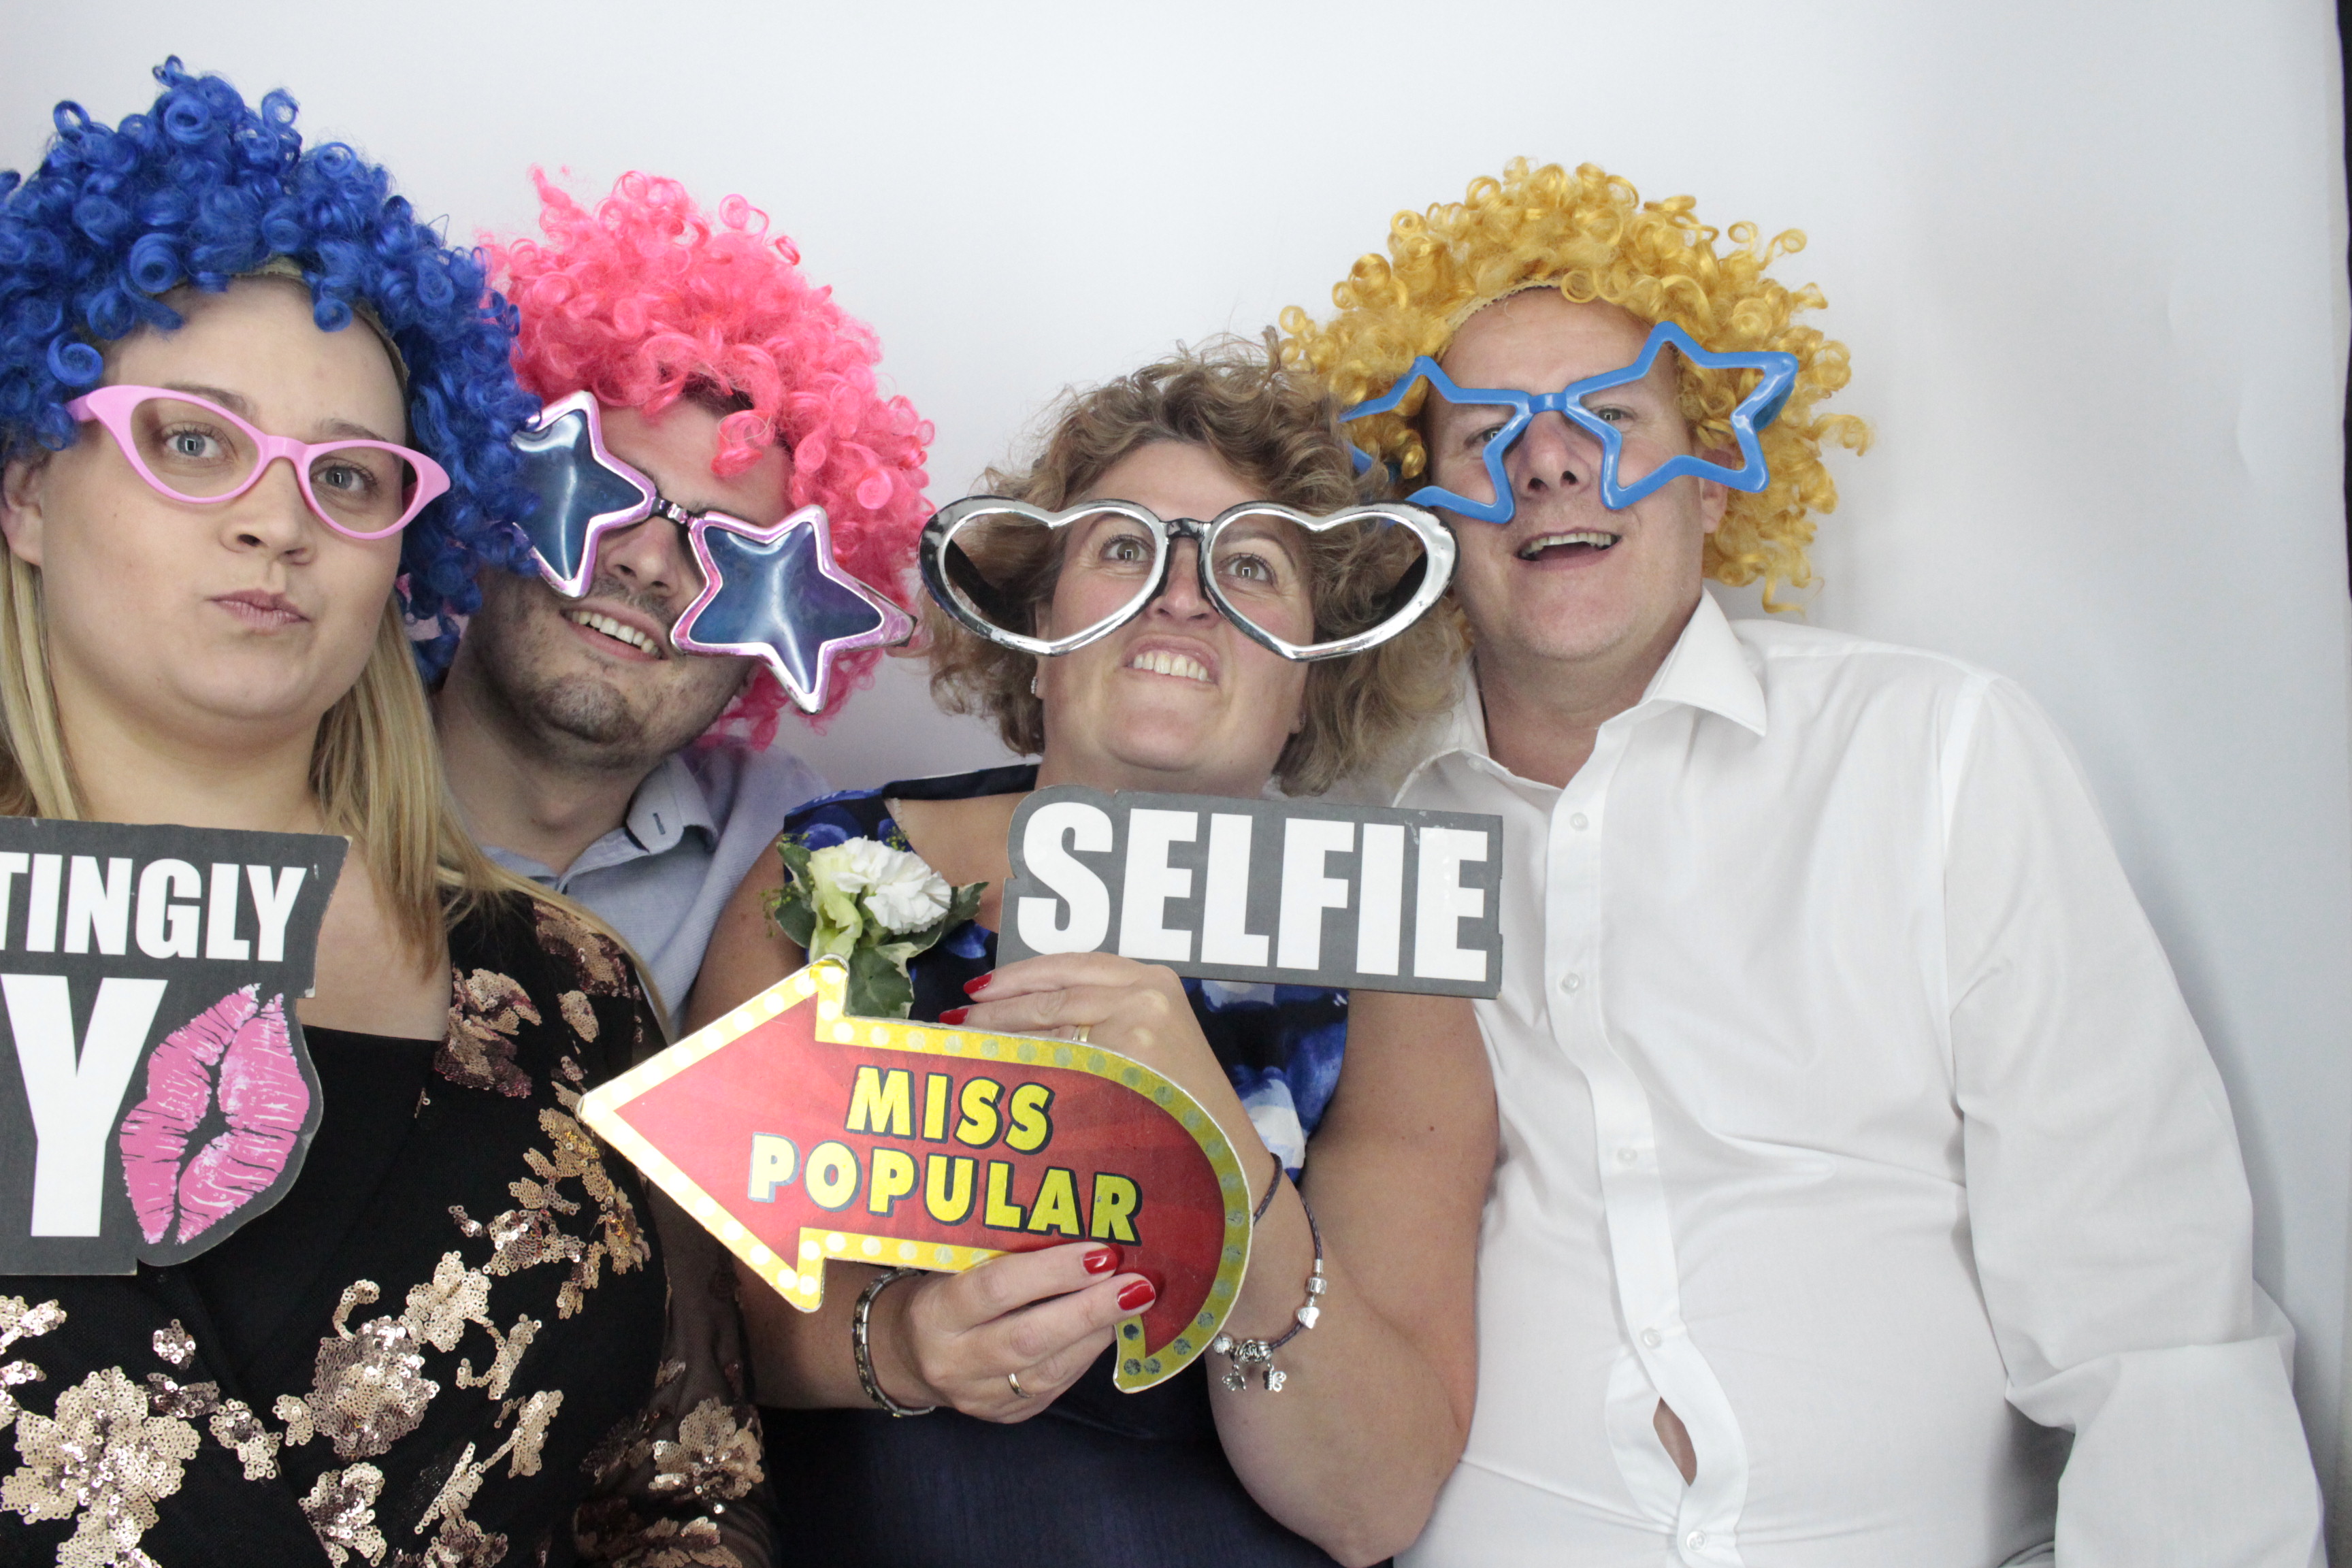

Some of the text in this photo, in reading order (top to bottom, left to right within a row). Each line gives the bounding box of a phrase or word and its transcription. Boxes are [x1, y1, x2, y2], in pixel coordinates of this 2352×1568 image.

[1017, 802, 1488, 982] SELFIE
[845, 1064, 1055, 1155] MISS
[747, 1132, 1142, 1245] POPULAR
